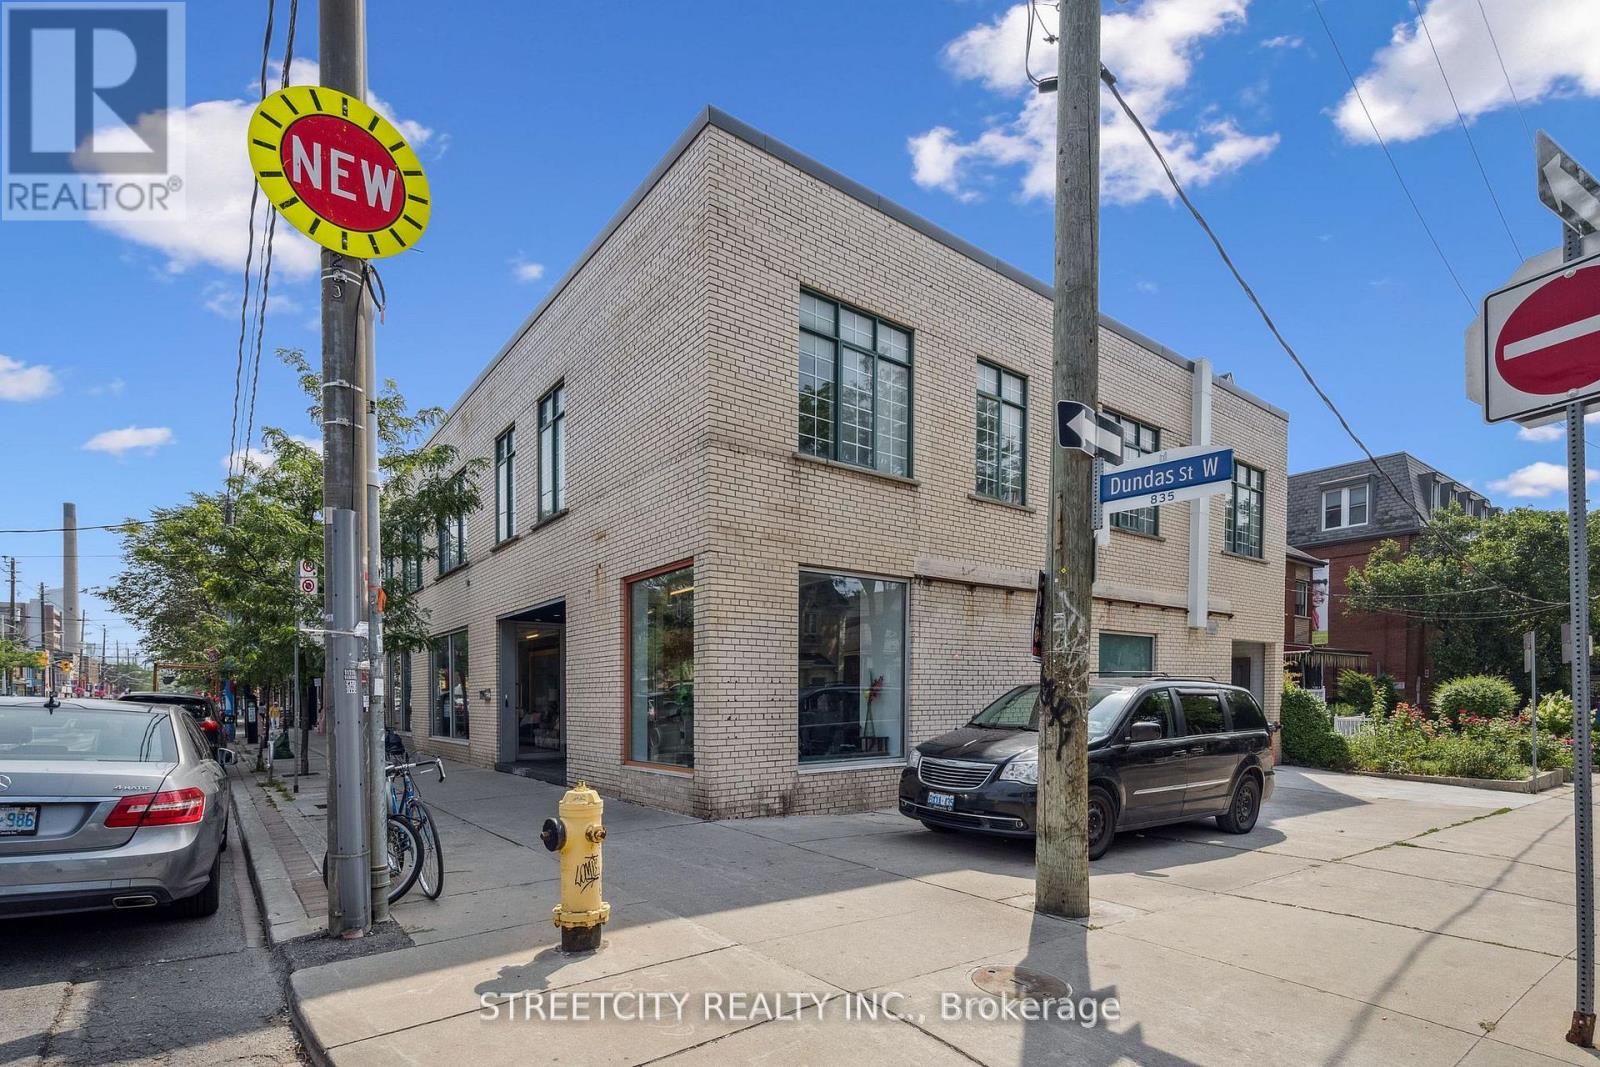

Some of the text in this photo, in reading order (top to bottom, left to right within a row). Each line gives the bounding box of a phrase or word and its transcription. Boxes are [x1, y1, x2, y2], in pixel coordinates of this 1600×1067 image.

[292, 135, 396, 212] NEW
[1110, 457, 1218, 495] Dundas St W
[1150, 491, 1175, 504] 835
